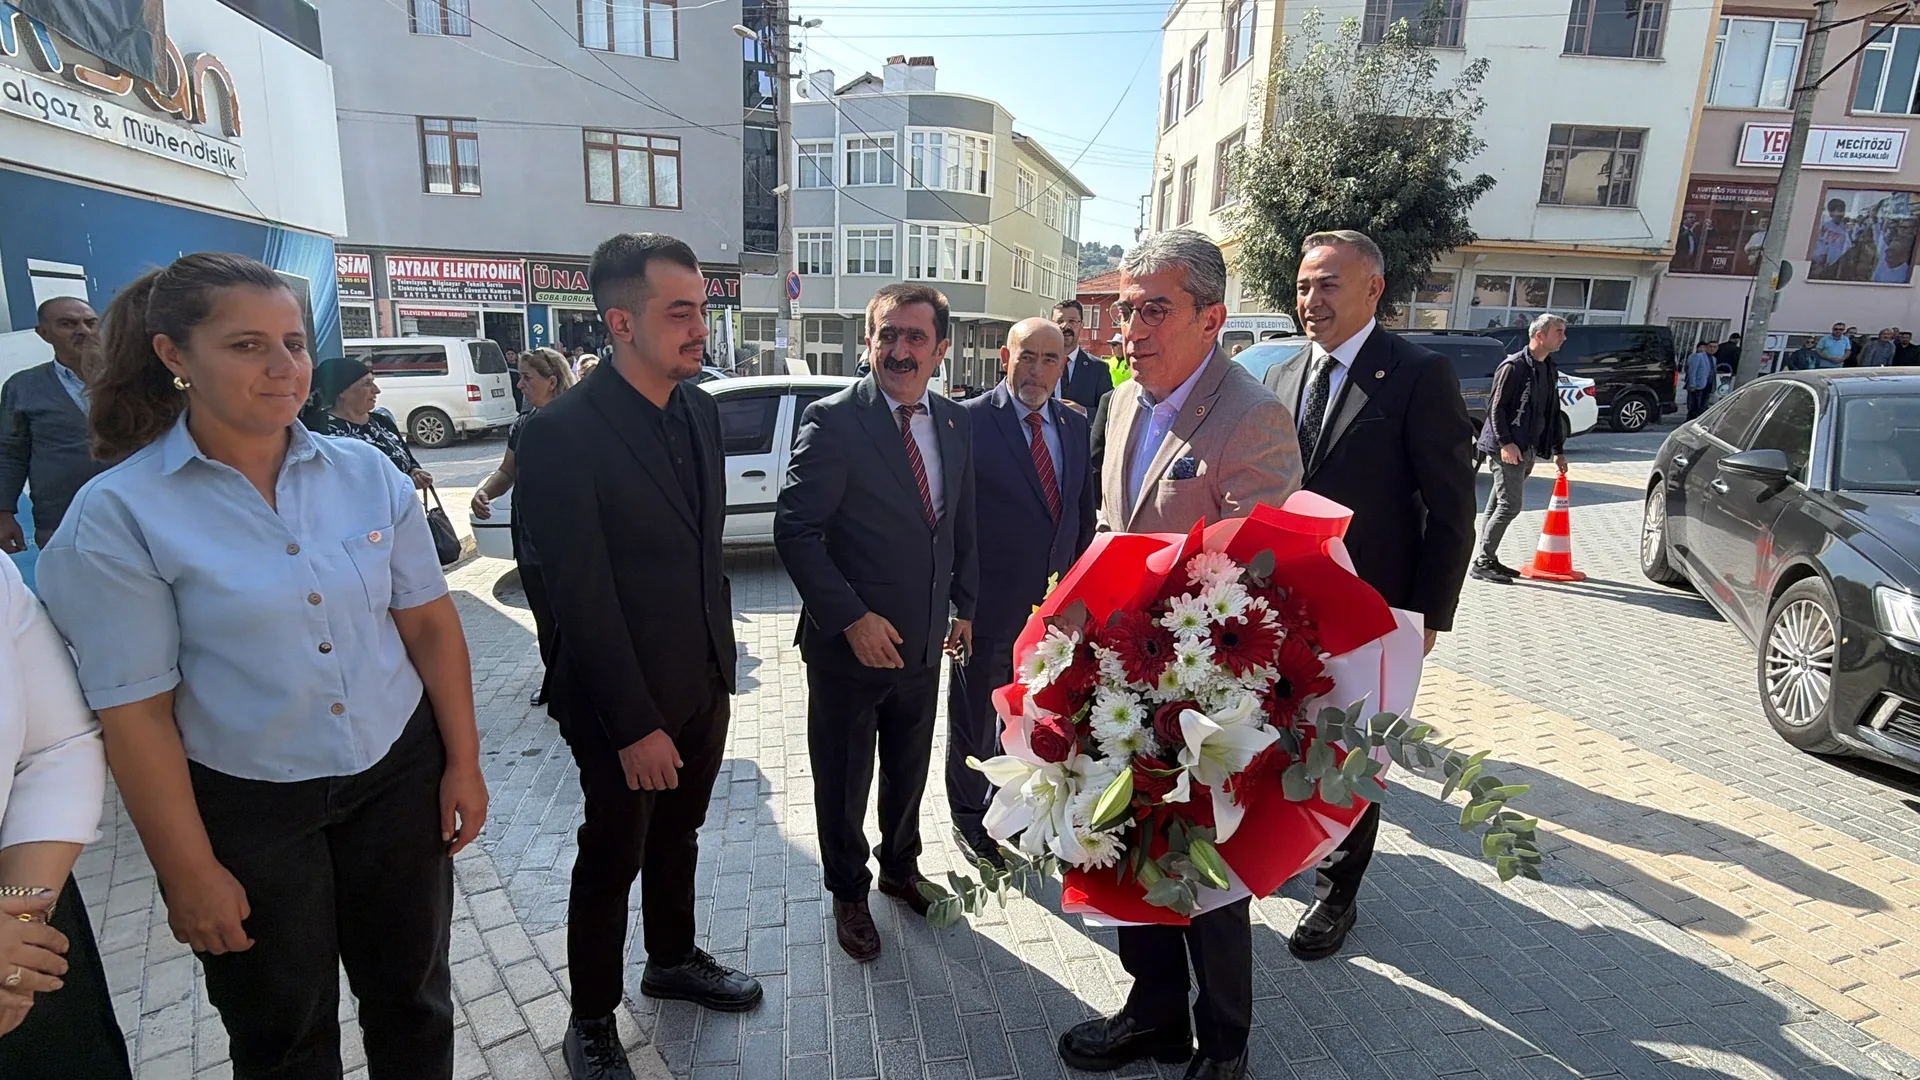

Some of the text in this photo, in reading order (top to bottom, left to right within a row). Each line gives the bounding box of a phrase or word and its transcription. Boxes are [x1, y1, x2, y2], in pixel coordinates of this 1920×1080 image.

[94, 105, 112, 129] &
[123, 116, 237, 170] Mühendislik
[1836, 137, 1893, 151] MECİTÖZÜ
[1833, 150, 1890, 160] İLÇE BAŞKANLIĞI
[388, 260, 439, 277] BAYRAK
[1225, 320, 1291, 328] ECİTÖZÜ BELEDİYESİ
